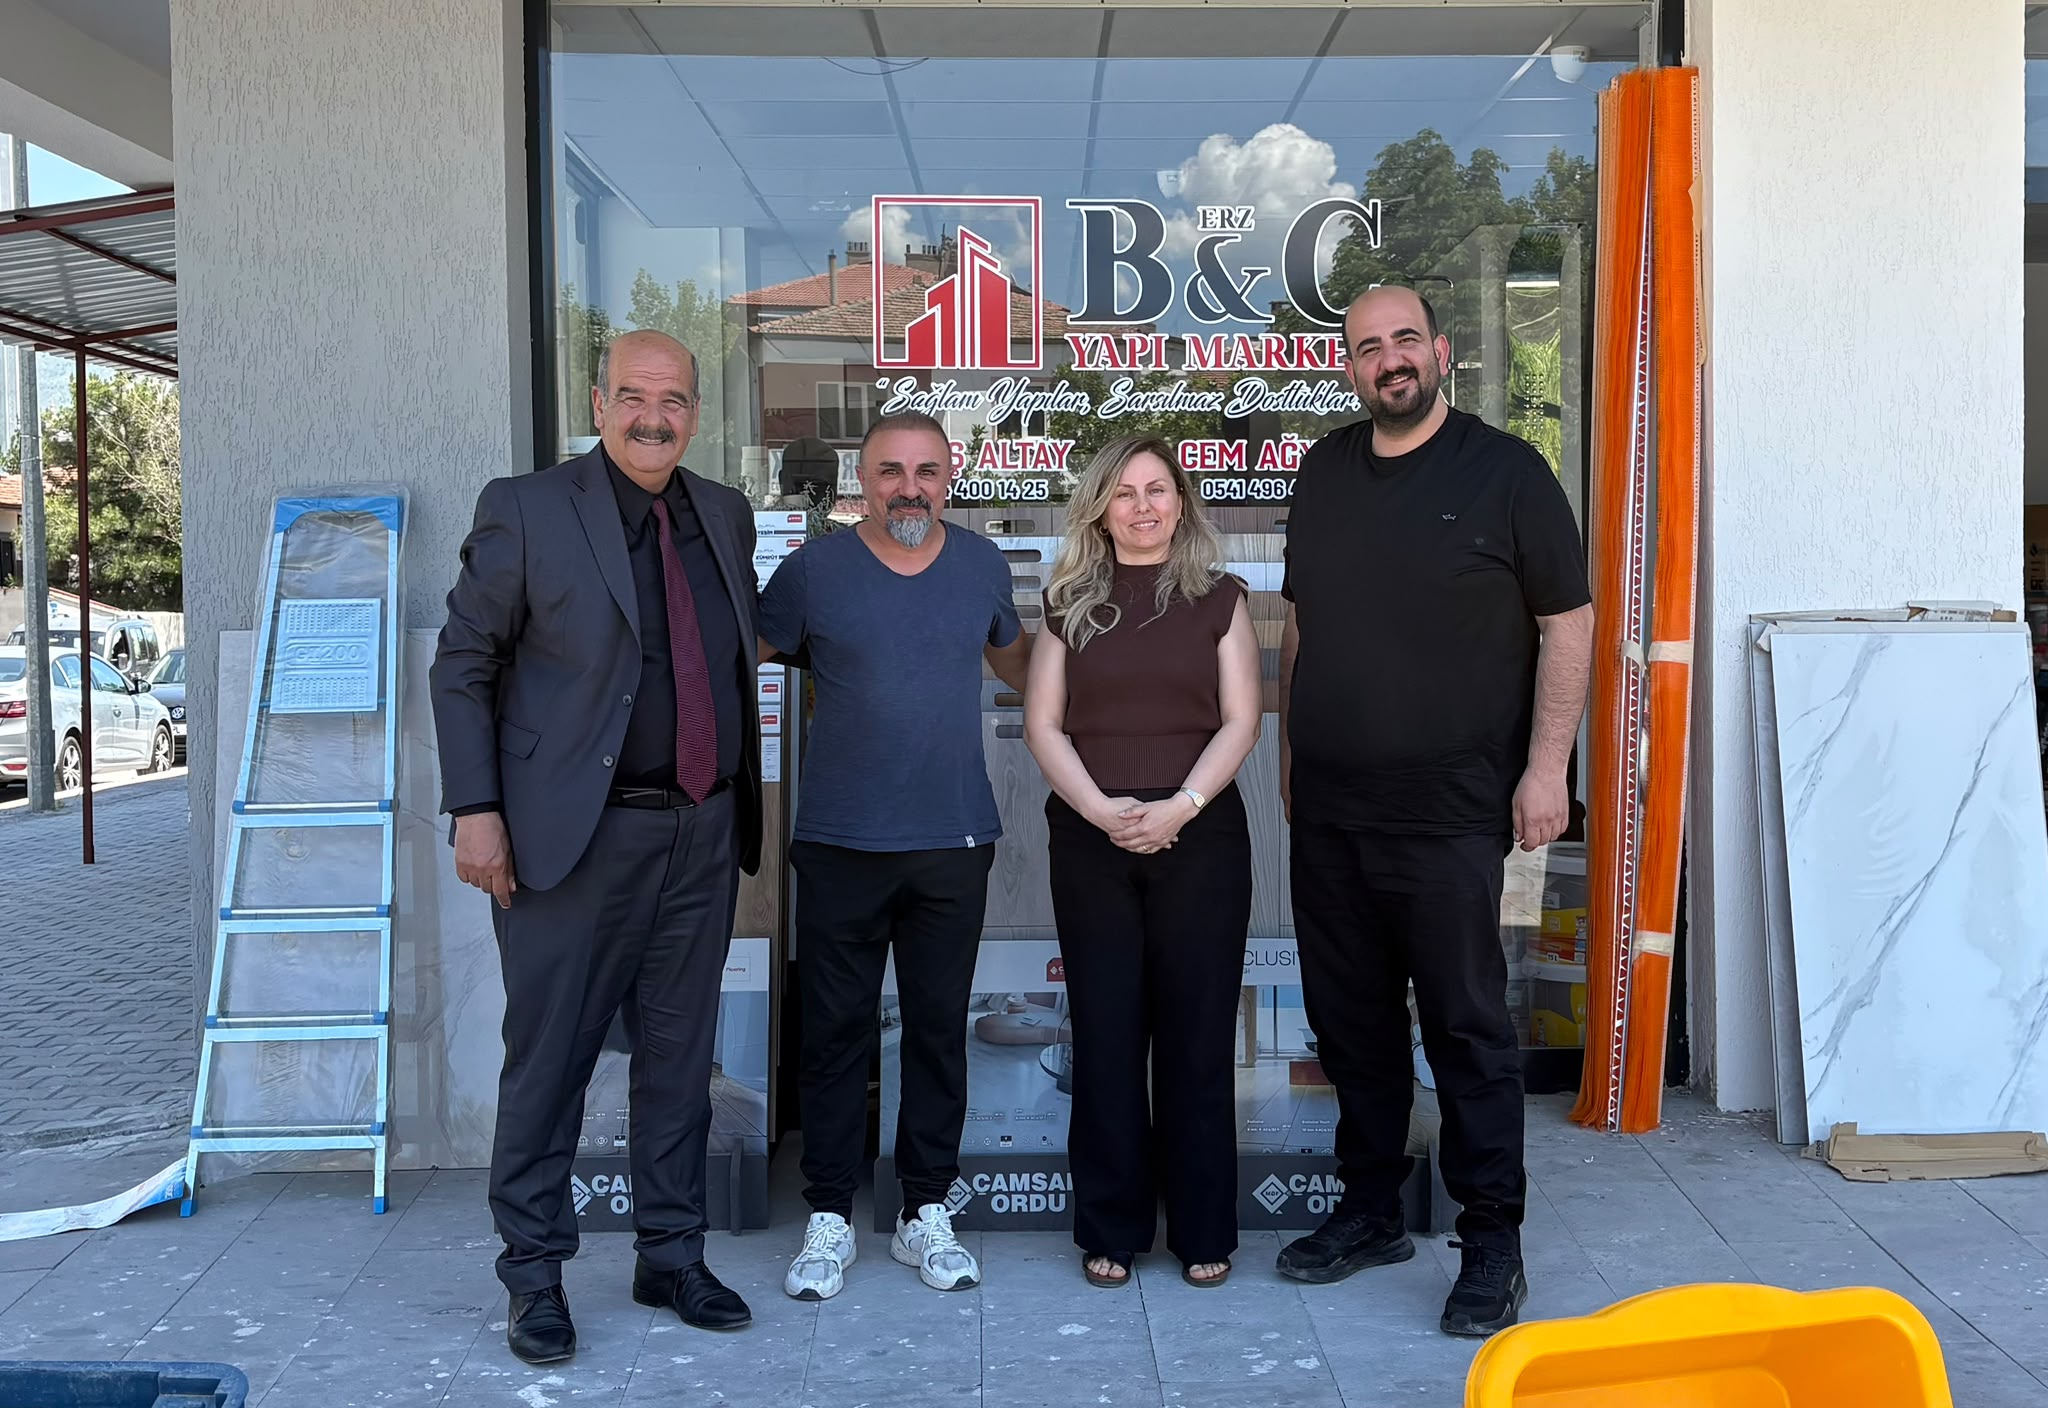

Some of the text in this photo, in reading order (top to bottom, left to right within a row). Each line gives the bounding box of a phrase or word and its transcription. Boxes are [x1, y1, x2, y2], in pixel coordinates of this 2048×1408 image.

[1198, 205, 1255, 231] ERZ
[1064, 333, 1169, 371] YAPI
[974, 440, 1075, 471] ALTAY
[1178, 439, 1247, 471] CEM
[997, 479, 1018, 499] 14
[1022, 479, 1048, 499] 25
[1202, 479, 1245, 499] 0541
[1248, 479, 1284, 499] 496
[1244, 950, 1299, 966] CLUSI
[610, 1194, 633, 1214] O
[991, 1193, 1066, 1213] ORDU
